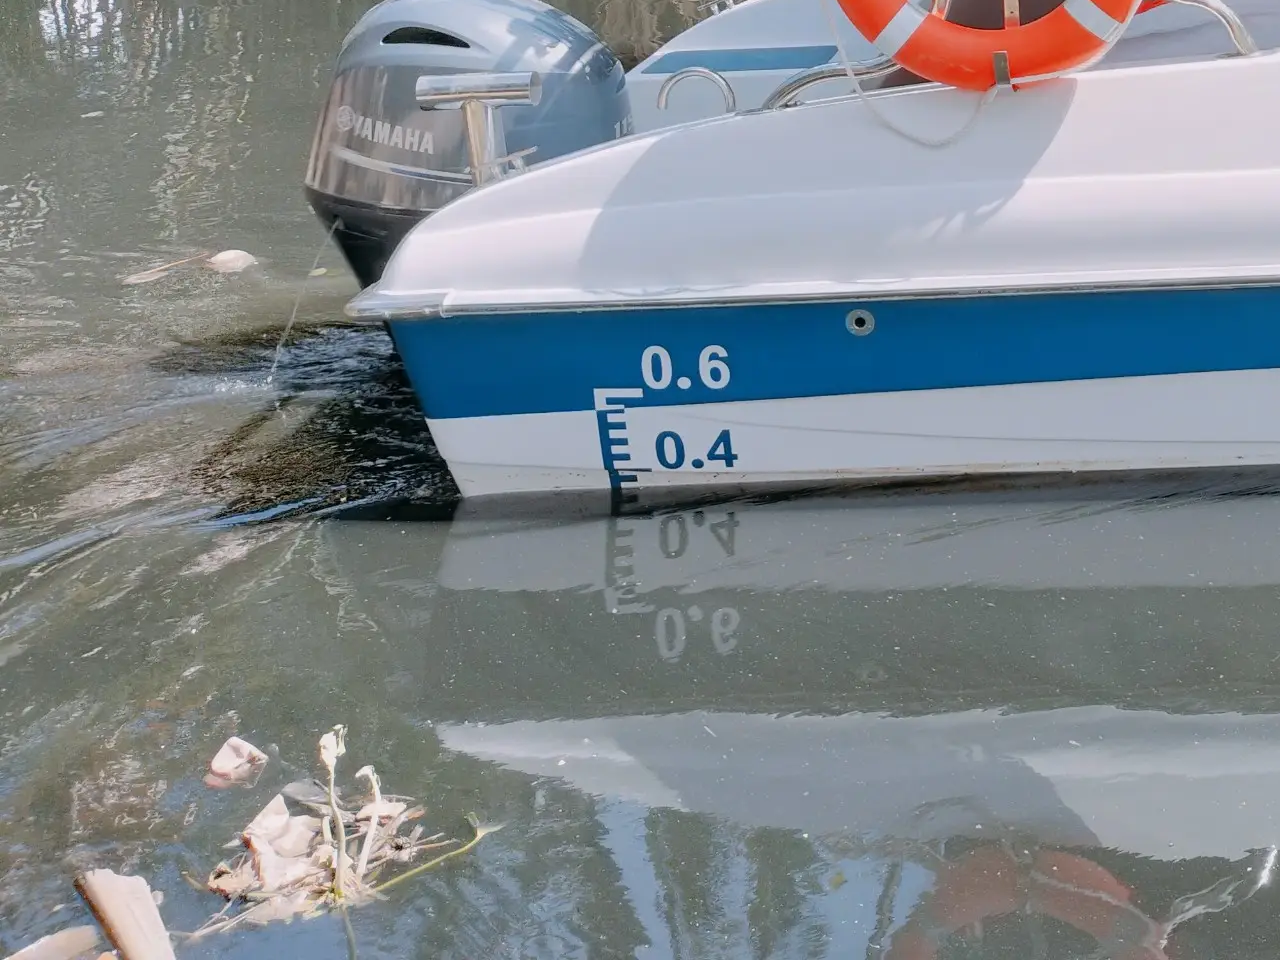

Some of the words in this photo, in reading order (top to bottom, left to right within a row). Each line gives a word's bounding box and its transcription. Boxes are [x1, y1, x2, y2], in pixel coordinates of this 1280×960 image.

[354, 115, 434, 154] YAMAHA
[641, 345, 731, 389] 0.6
[655, 429, 738, 469] 0.4
